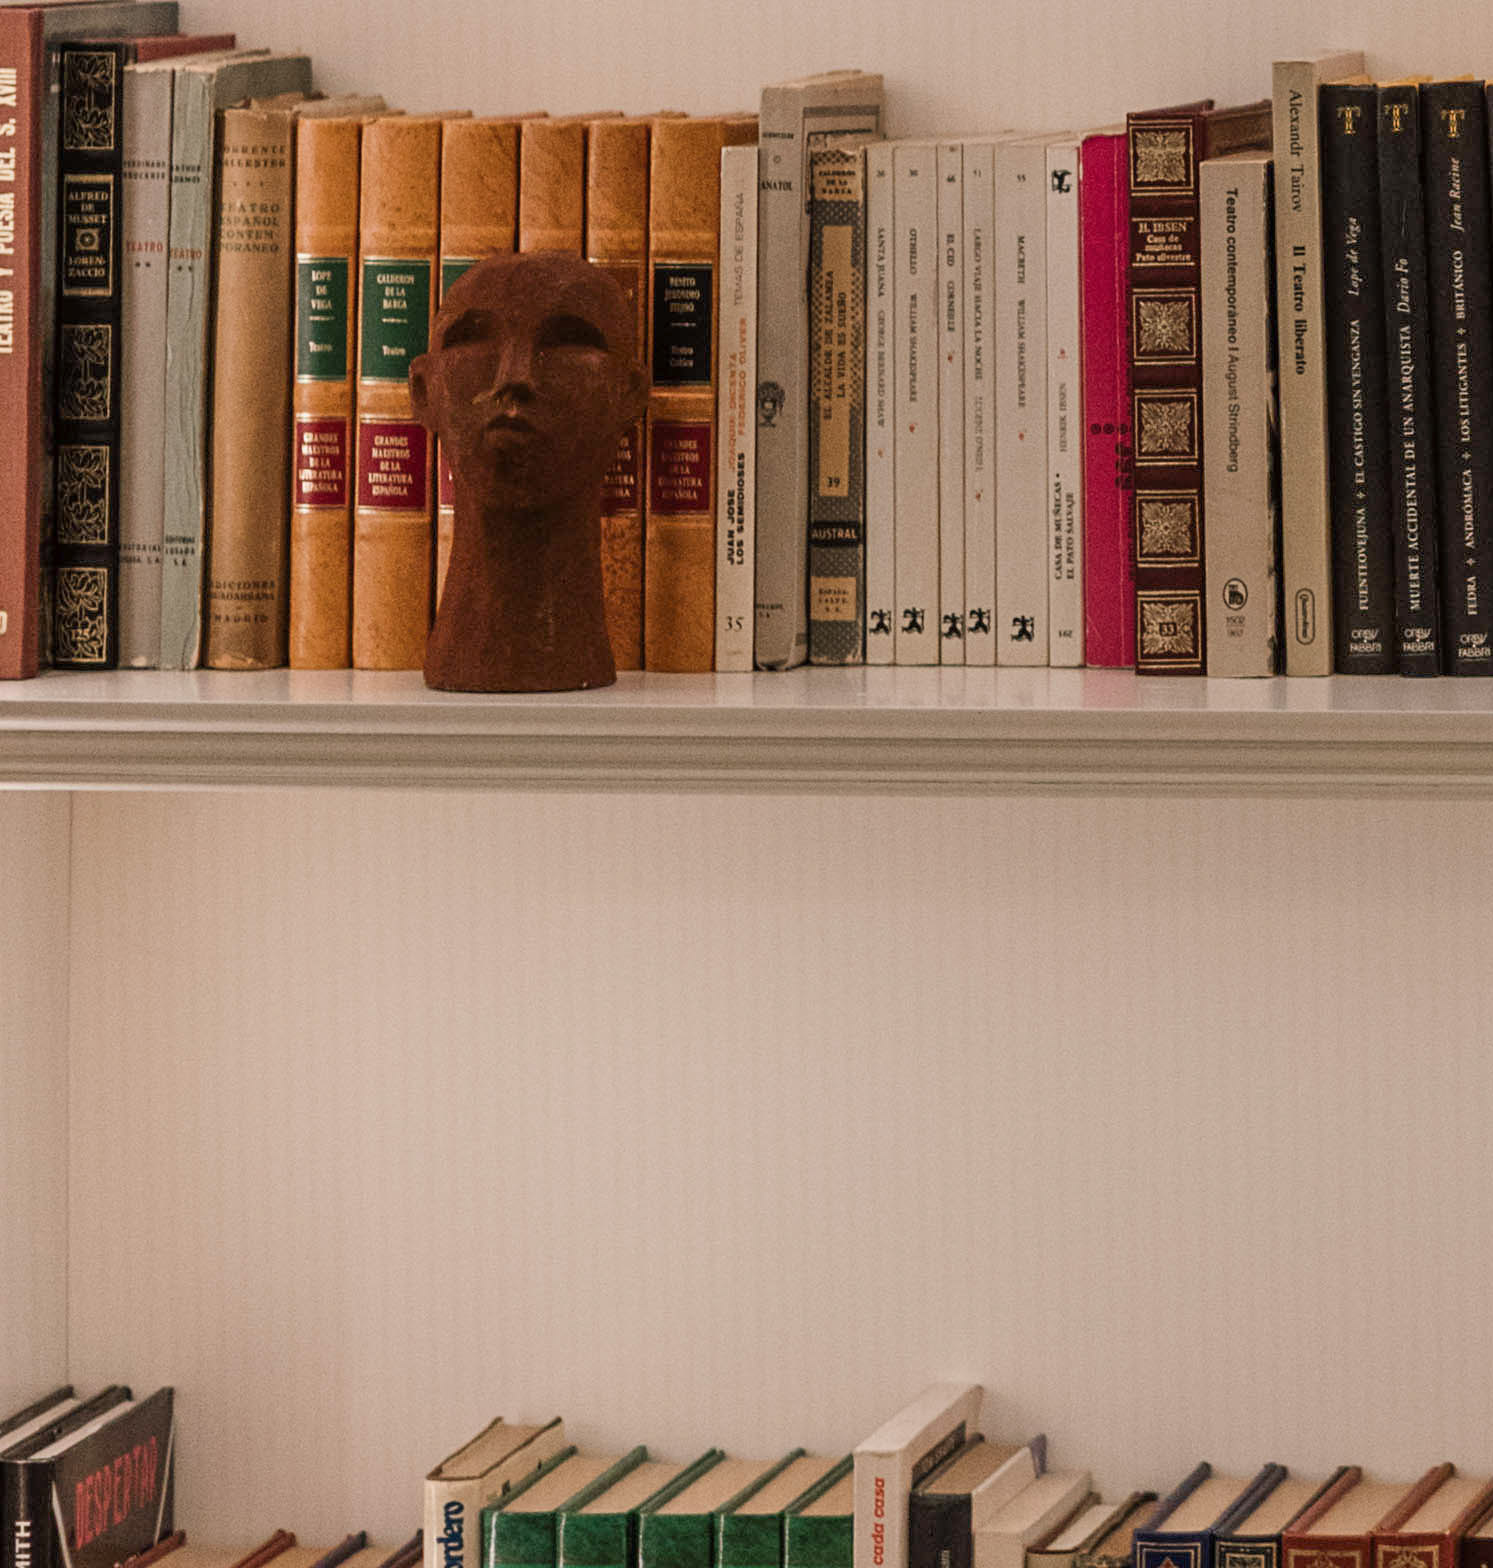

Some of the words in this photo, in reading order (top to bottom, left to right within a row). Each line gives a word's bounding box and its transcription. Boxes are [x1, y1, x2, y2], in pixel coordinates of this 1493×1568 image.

[1293, 246, 1306, 258] Il
[1293, 266, 1306, 312] Teatro
[1293, 317, 1307, 376] liberato
[874, 1477, 885, 1518] casa
[872, 1523, 884, 1565] cada
